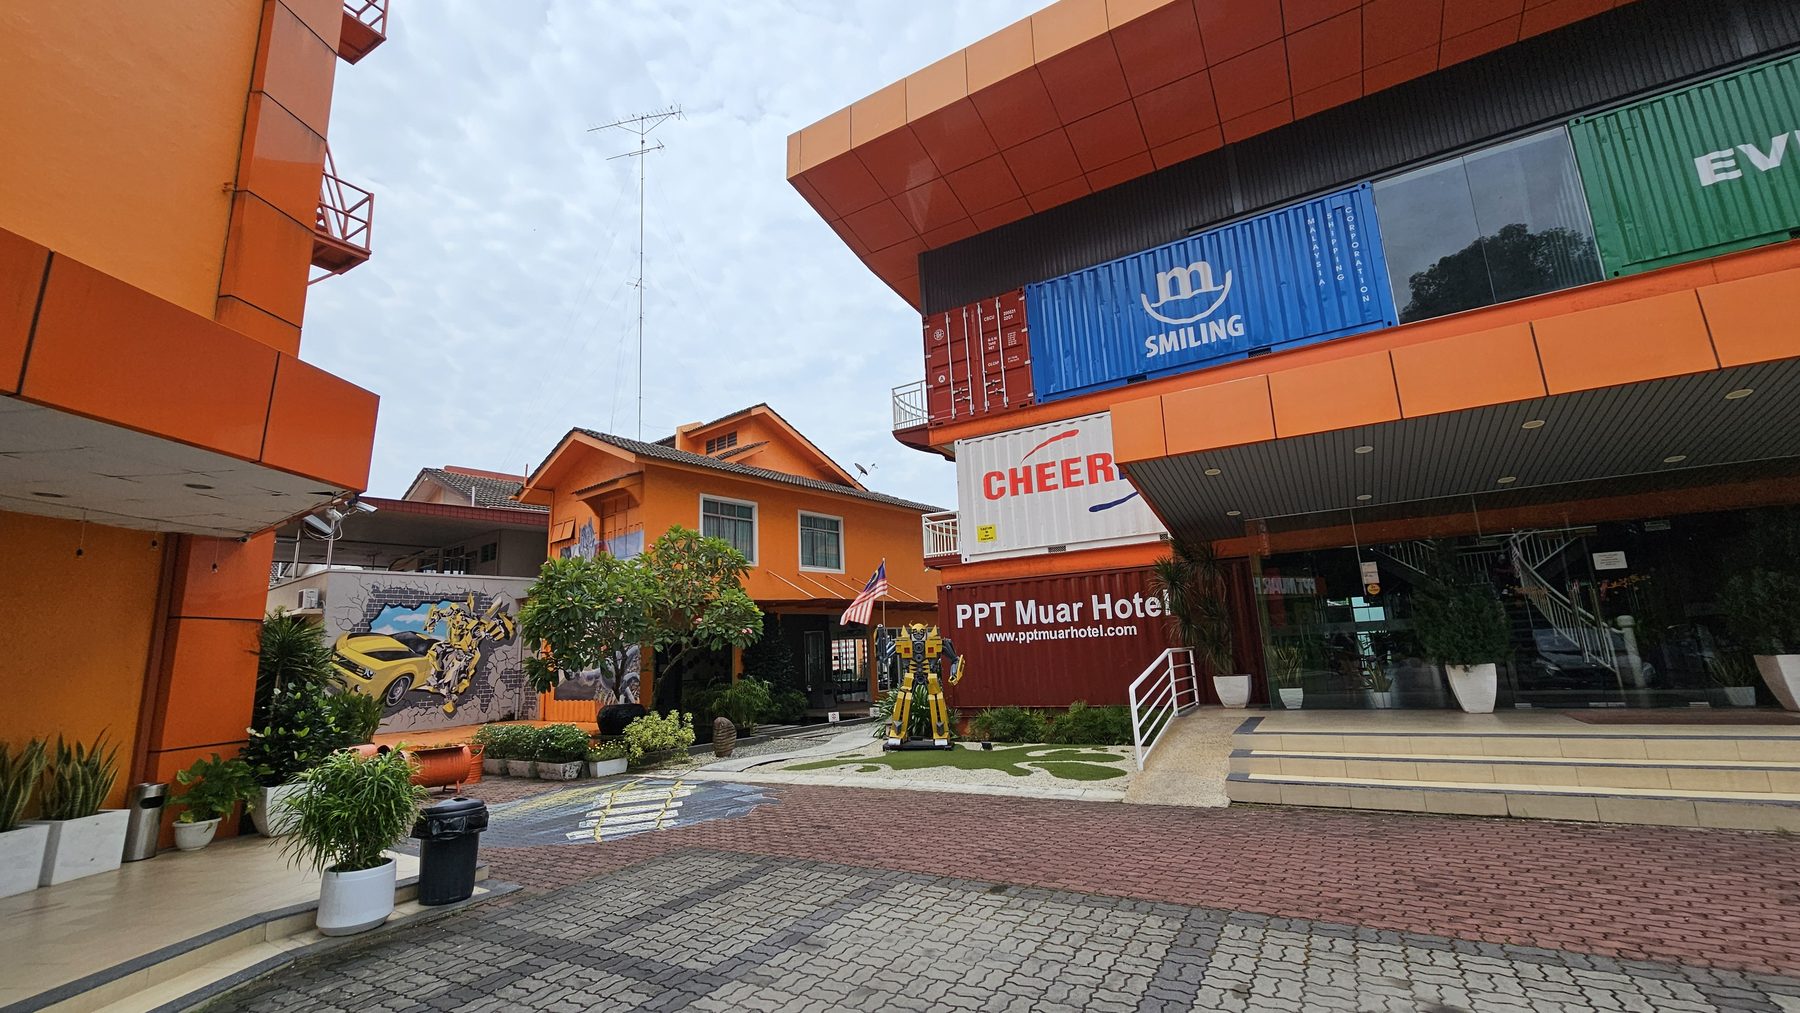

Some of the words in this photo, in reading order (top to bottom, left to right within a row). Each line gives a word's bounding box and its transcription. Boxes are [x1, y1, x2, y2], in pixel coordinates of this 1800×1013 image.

[1694, 130, 1800, 187] EV
[1308, 218, 1325, 287] MALAYSIA
[1327, 213, 1344, 281] SHIPPING
[1345, 207, 1369, 302] CORPORATION
[1145, 314, 1245, 358] SMILING
[983, 452, 1126, 500] CHEER
[956, 602, 1006, 629] PPT
[1015, 599, 1083, 625] Muar
[1091, 589, 1171, 621] Hotel
[986, 624, 1137, 644] www.pptmuarhotel.com
